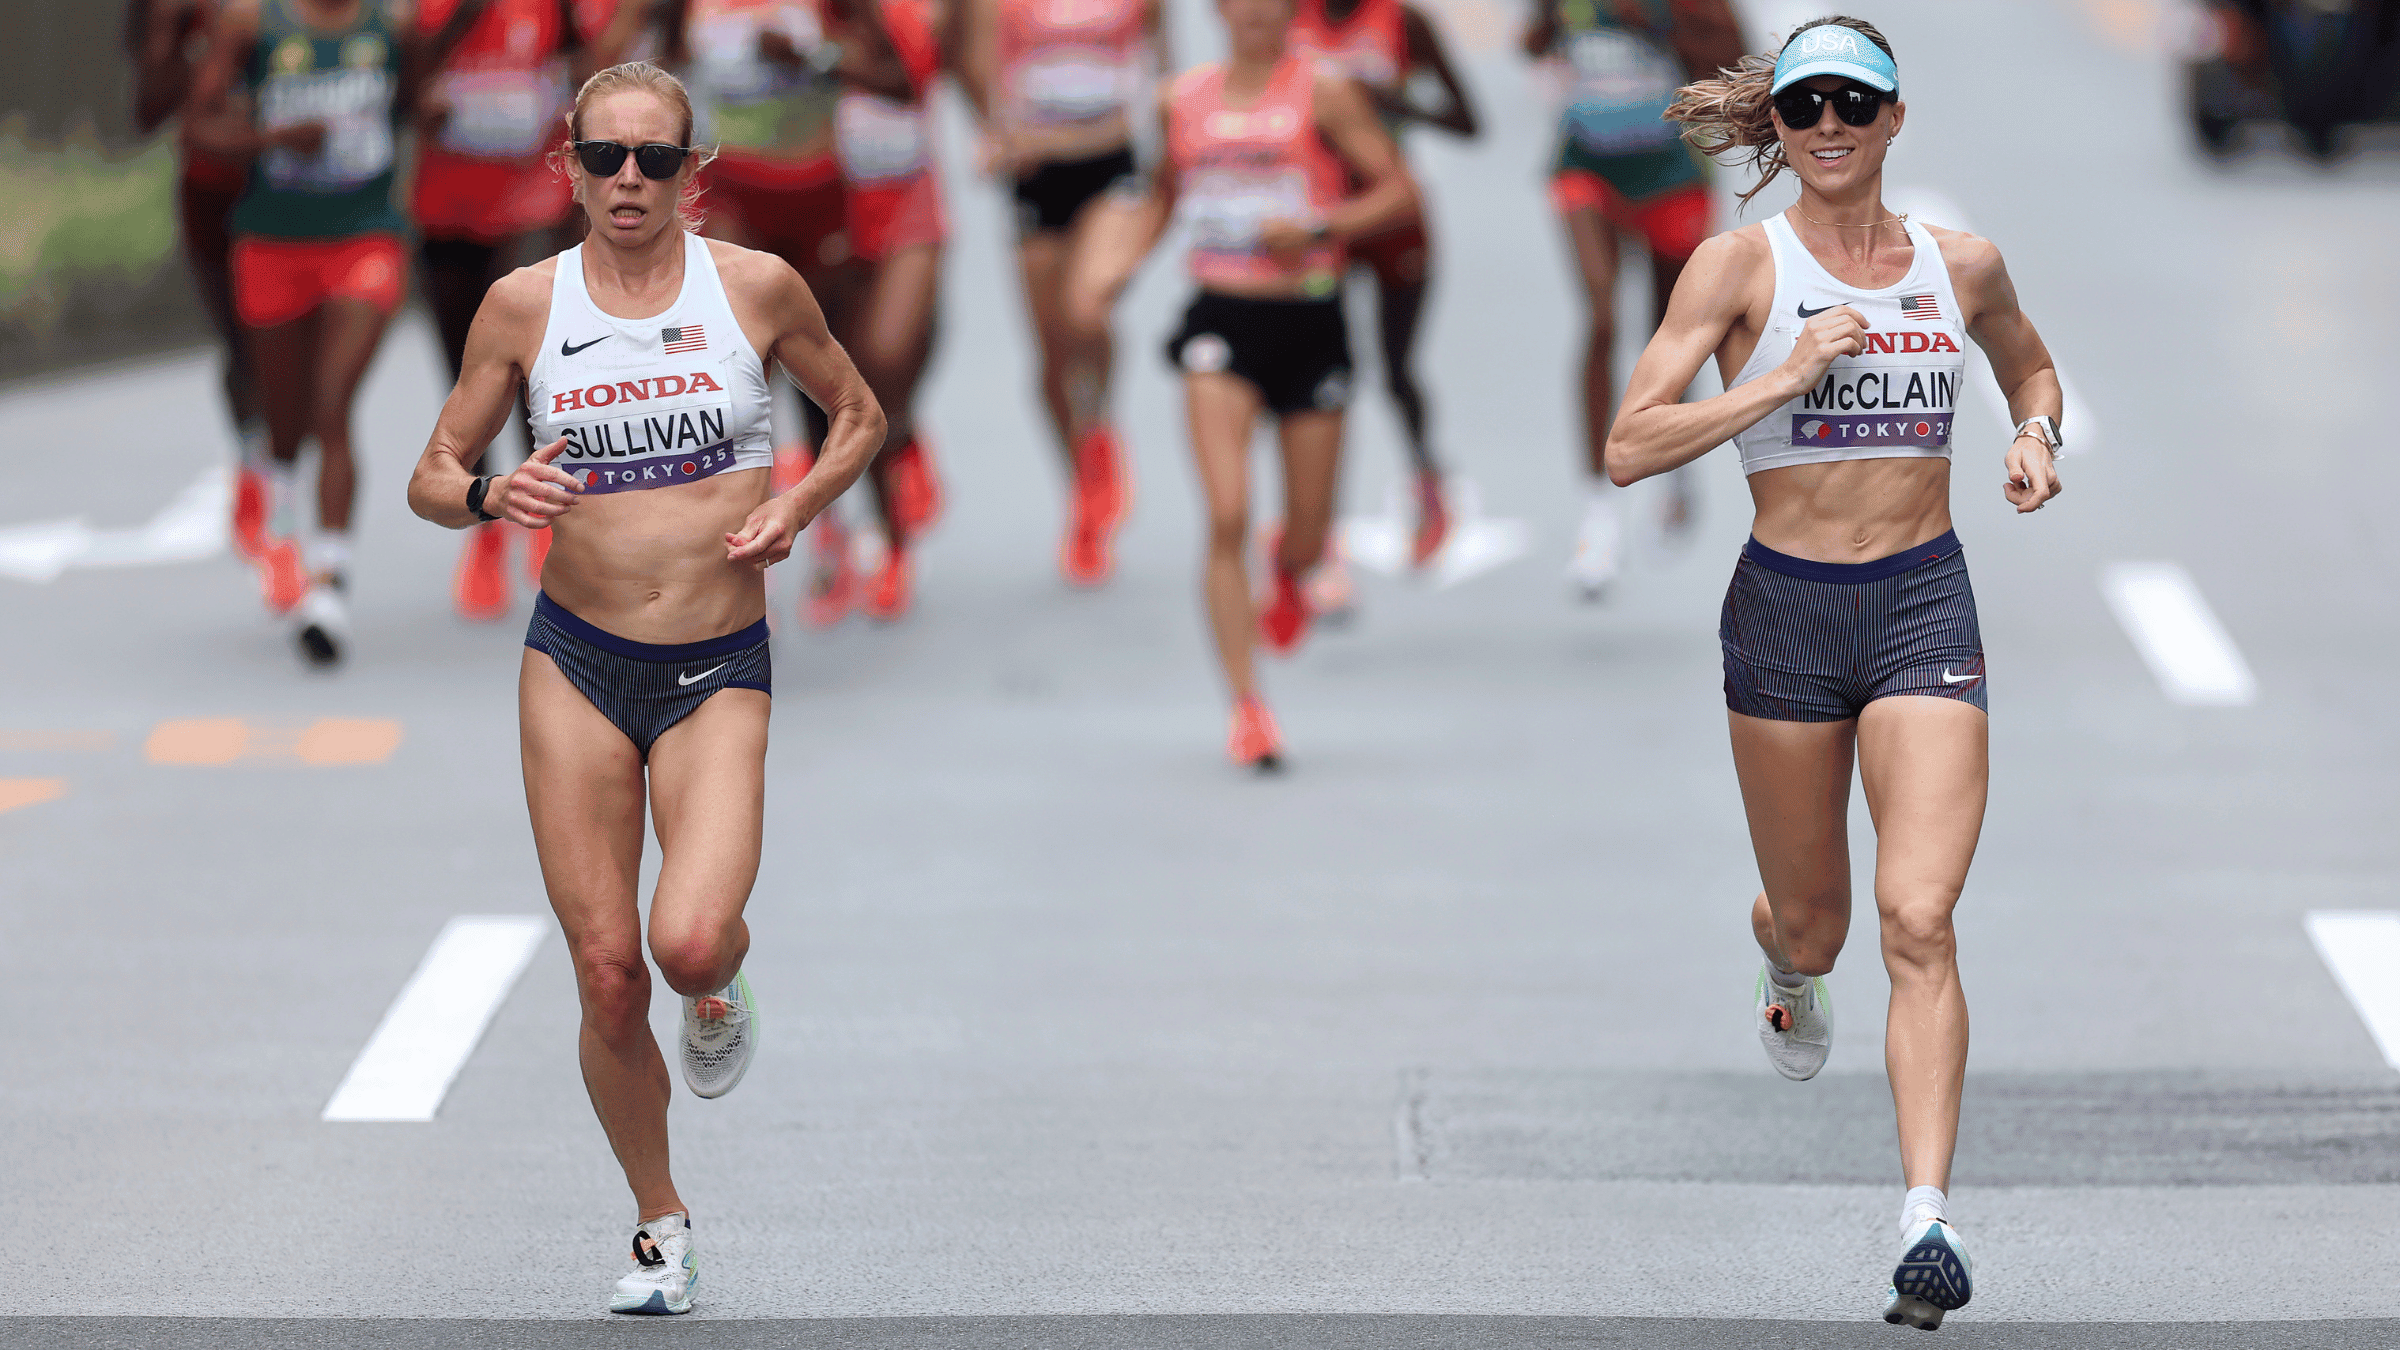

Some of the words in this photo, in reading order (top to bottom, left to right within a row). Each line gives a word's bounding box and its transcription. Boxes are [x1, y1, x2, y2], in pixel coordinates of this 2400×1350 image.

[1802, 32, 1858, 56] USA
[551, 371, 723, 414] HONDA
[1804, 371, 1955, 411] McCLAIN
[560, 407, 725, 459] SULLIVAN
